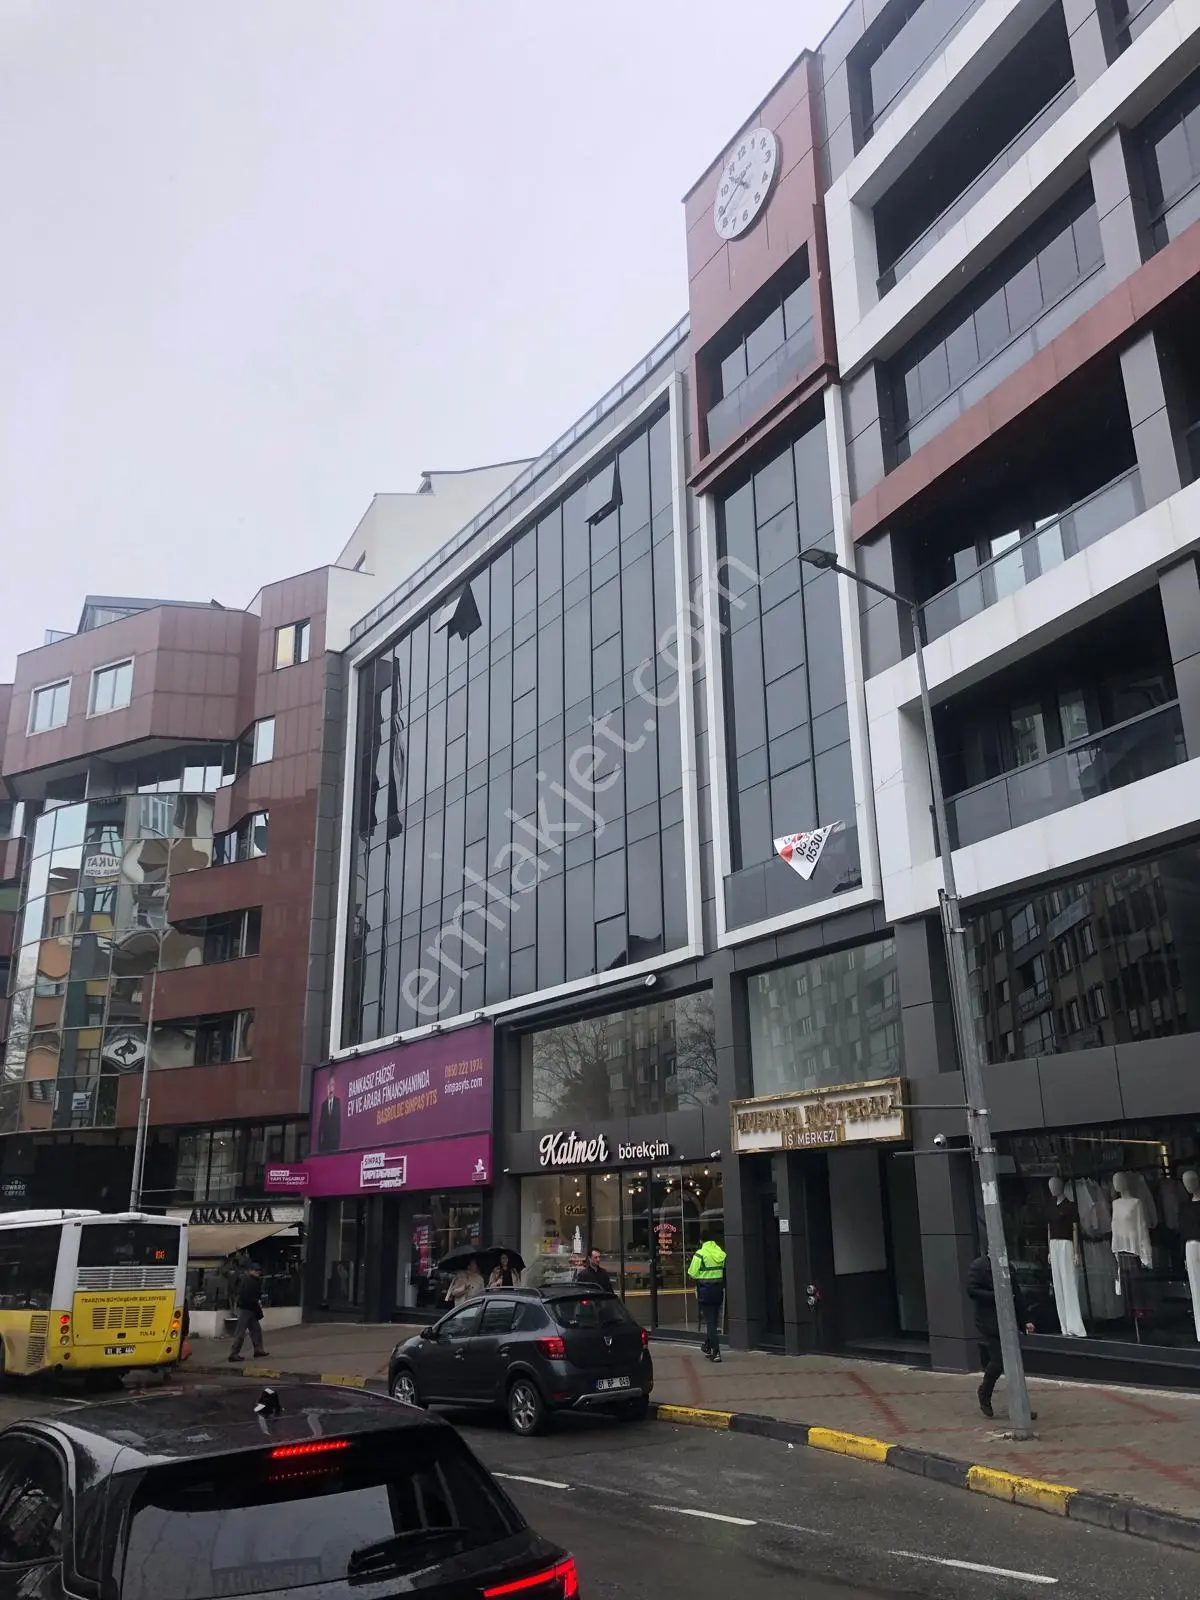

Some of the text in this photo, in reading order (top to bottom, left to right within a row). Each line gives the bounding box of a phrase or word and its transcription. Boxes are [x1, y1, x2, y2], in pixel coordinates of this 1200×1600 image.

[750, 138, 756, 149] 1
[760, 137, 767, 150] 2
[737, 145, 746, 160] 12
[764, 149, 772, 163] 3
[761, 171, 769, 184] 4
[720, 184, 730, 197] 10
[754, 192, 761, 204] 5
[742, 209, 749, 221] 6
[722, 217, 729, 229] 8
[731, 216, 737, 230] 7
[805, 834, 823, 864] 0530
[798, 1129, 838, 1146] MERKEZİ
[539, 1130, 669, 1166] Katmer börekçim
